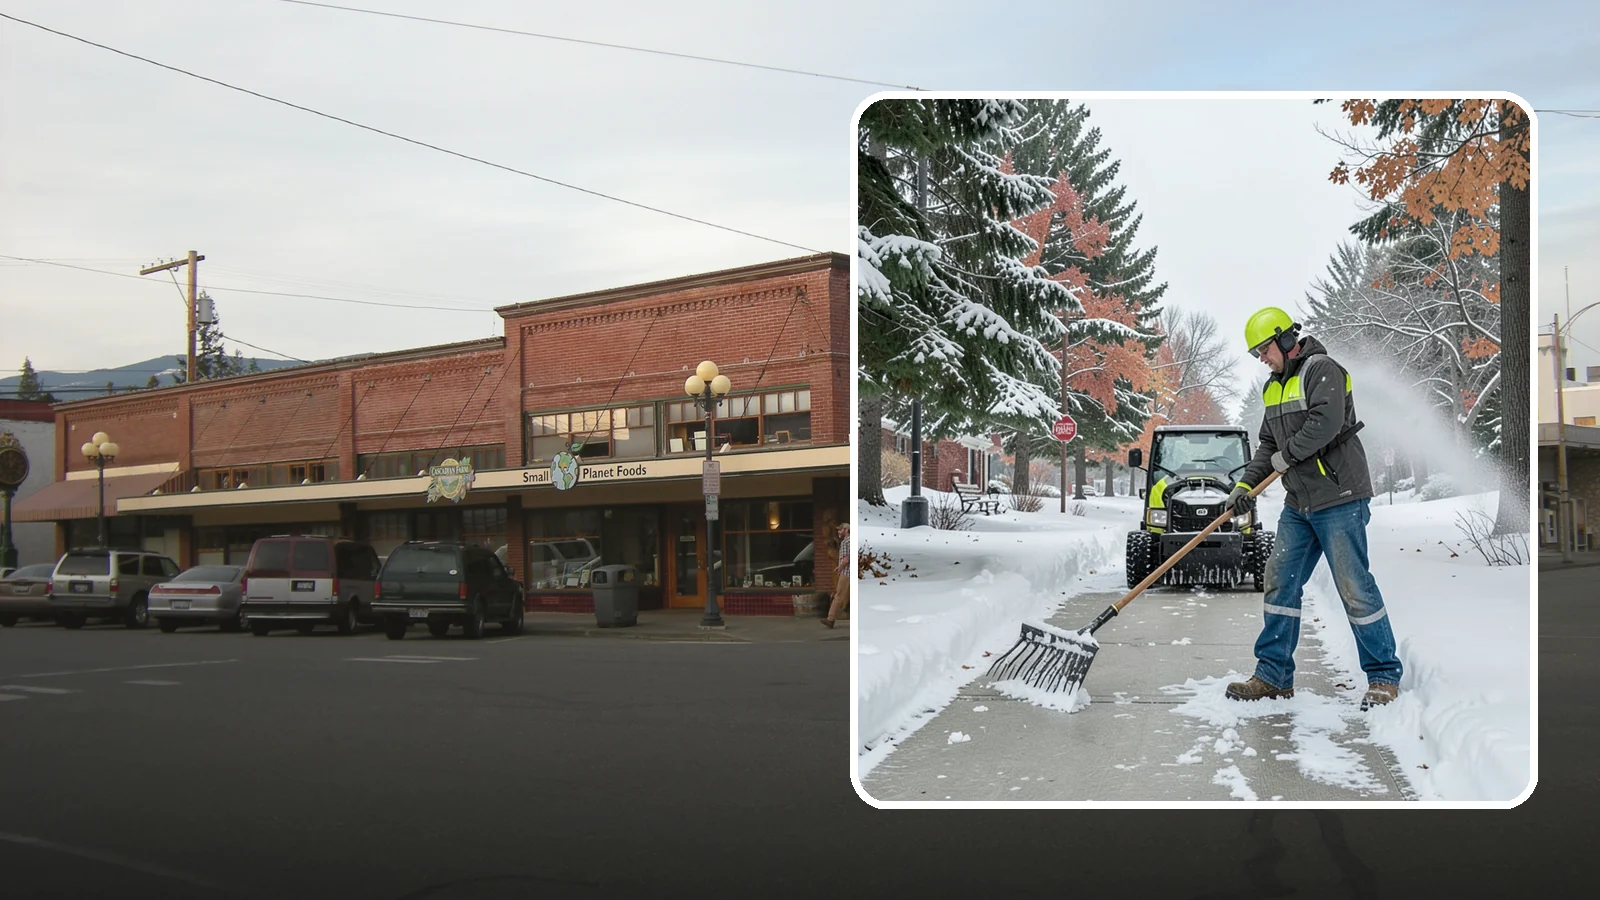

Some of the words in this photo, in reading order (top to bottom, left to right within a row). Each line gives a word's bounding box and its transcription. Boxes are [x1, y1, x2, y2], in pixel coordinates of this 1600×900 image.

[523, 471, 549, 483] Small
[582, 467, 614, 479] Planet
[616, 464, 647, 477] Foods
